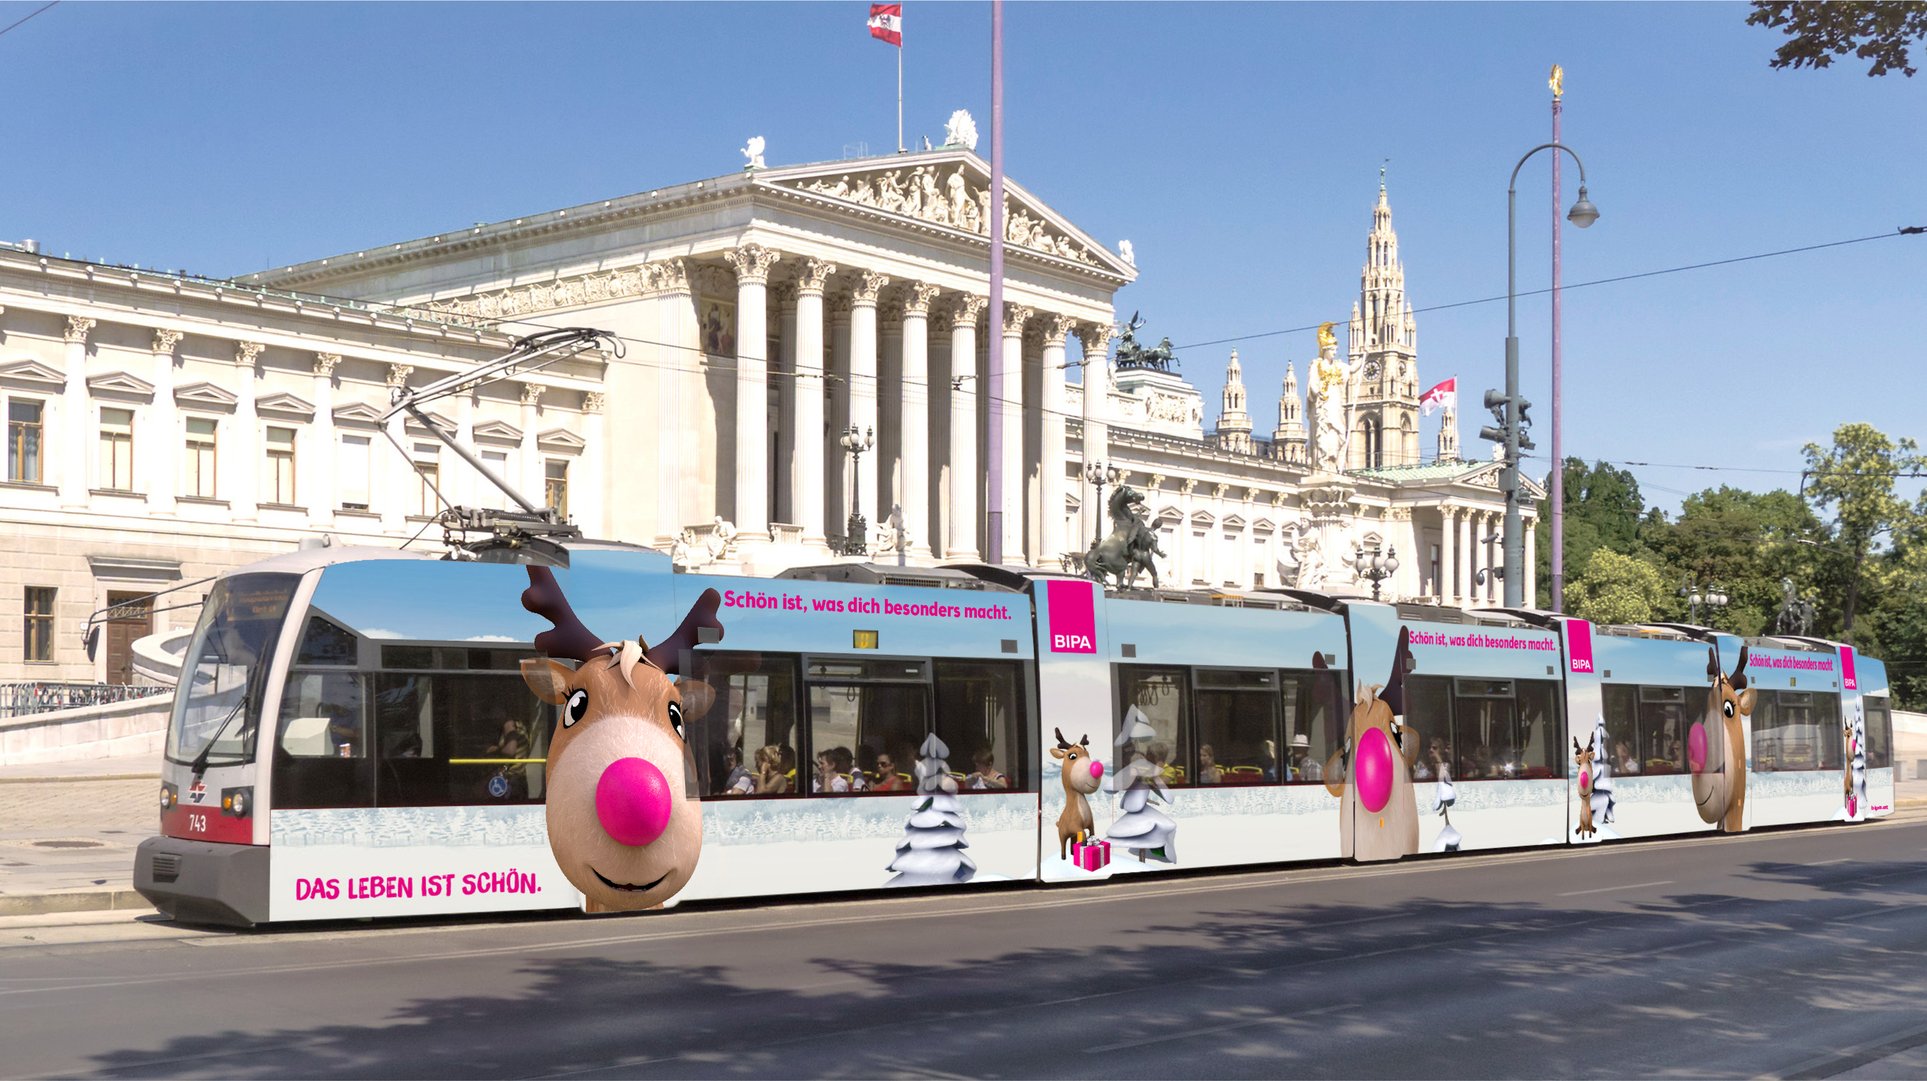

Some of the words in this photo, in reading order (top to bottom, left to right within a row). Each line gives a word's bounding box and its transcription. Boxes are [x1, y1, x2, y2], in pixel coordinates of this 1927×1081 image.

[724, 590, 779, 609] Schön
[783, 594, 808, 613] ist,
[812, 599, 845, 613] was
[848, 597, 881, 614] dich
[884, 599, 961, 618] besonders
[964, 605, 1012, 620] macht.
[1055, 634, 1092, 649] BIPA
[1409, 631, 1434, 645] Schön
[1436, 633, 1448, 647] ist,
[1450, 636, 1465, 647] was
[1467, 634, 1484, 647] dich
[1485, 636, 1527, 650] besonders
[1528, 639, 1556, 651] macht.
[1572, 659, 1592, 670] BIPA
[1749, 653, 1764, 667] Schön
[1773, 657, 1783, 668] was
[1783, 656, 1793, 669] dich
[1793, 657, 1818, 671] besonders
[1844, 678, 1856, 688] BIPA
[189, 814, 207, 832] 743
[296, 877, 341, 900] DAS
[348, 876, 413, 900] LEBEN
[421, 873, 456, 897] IST
[462, 868, 542, 895] SCHÖN.
